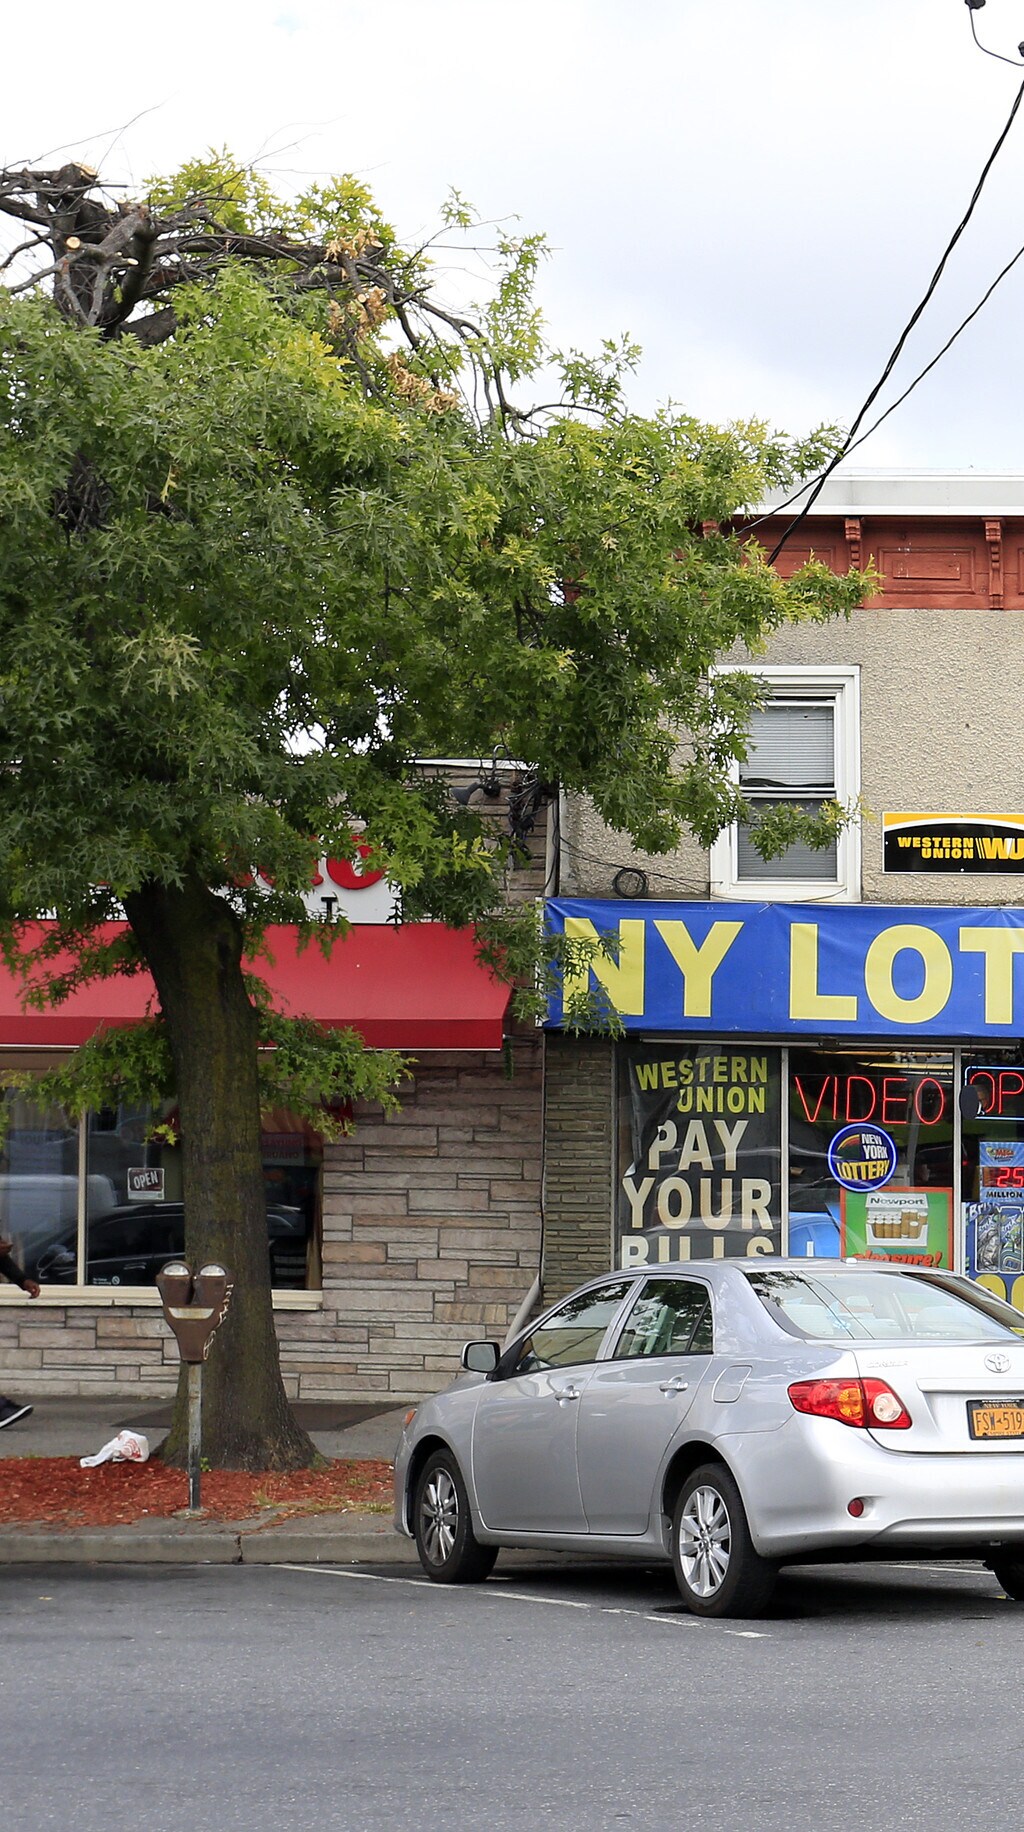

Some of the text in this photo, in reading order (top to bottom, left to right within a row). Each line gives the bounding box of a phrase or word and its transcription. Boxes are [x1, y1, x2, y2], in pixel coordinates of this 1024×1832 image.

[897, 836, 974, 848] WESTERN
[921, 848, 974, 859] UNION
[562, 917, 745, 1017] NY
[636, 1056, 768, 1091] WESTERN
[676, 1087, 765, 1113] UNION
[795, 1076, 945, 1125] VIDEO
[648, 1119, 749, 1171] PAY
[862, 1133, 882, 1145] NEW
[863, 1145, 889, 1159] YORK
[133, 1170, 159, 1189] OPEN
[836, 1160, 890, 1180] LOTTERY
[996, 1167, 1024, 1188] 25
[622, 1177, 774, 1230] YOUR
[870, 1197, 925, 1207] Newport
